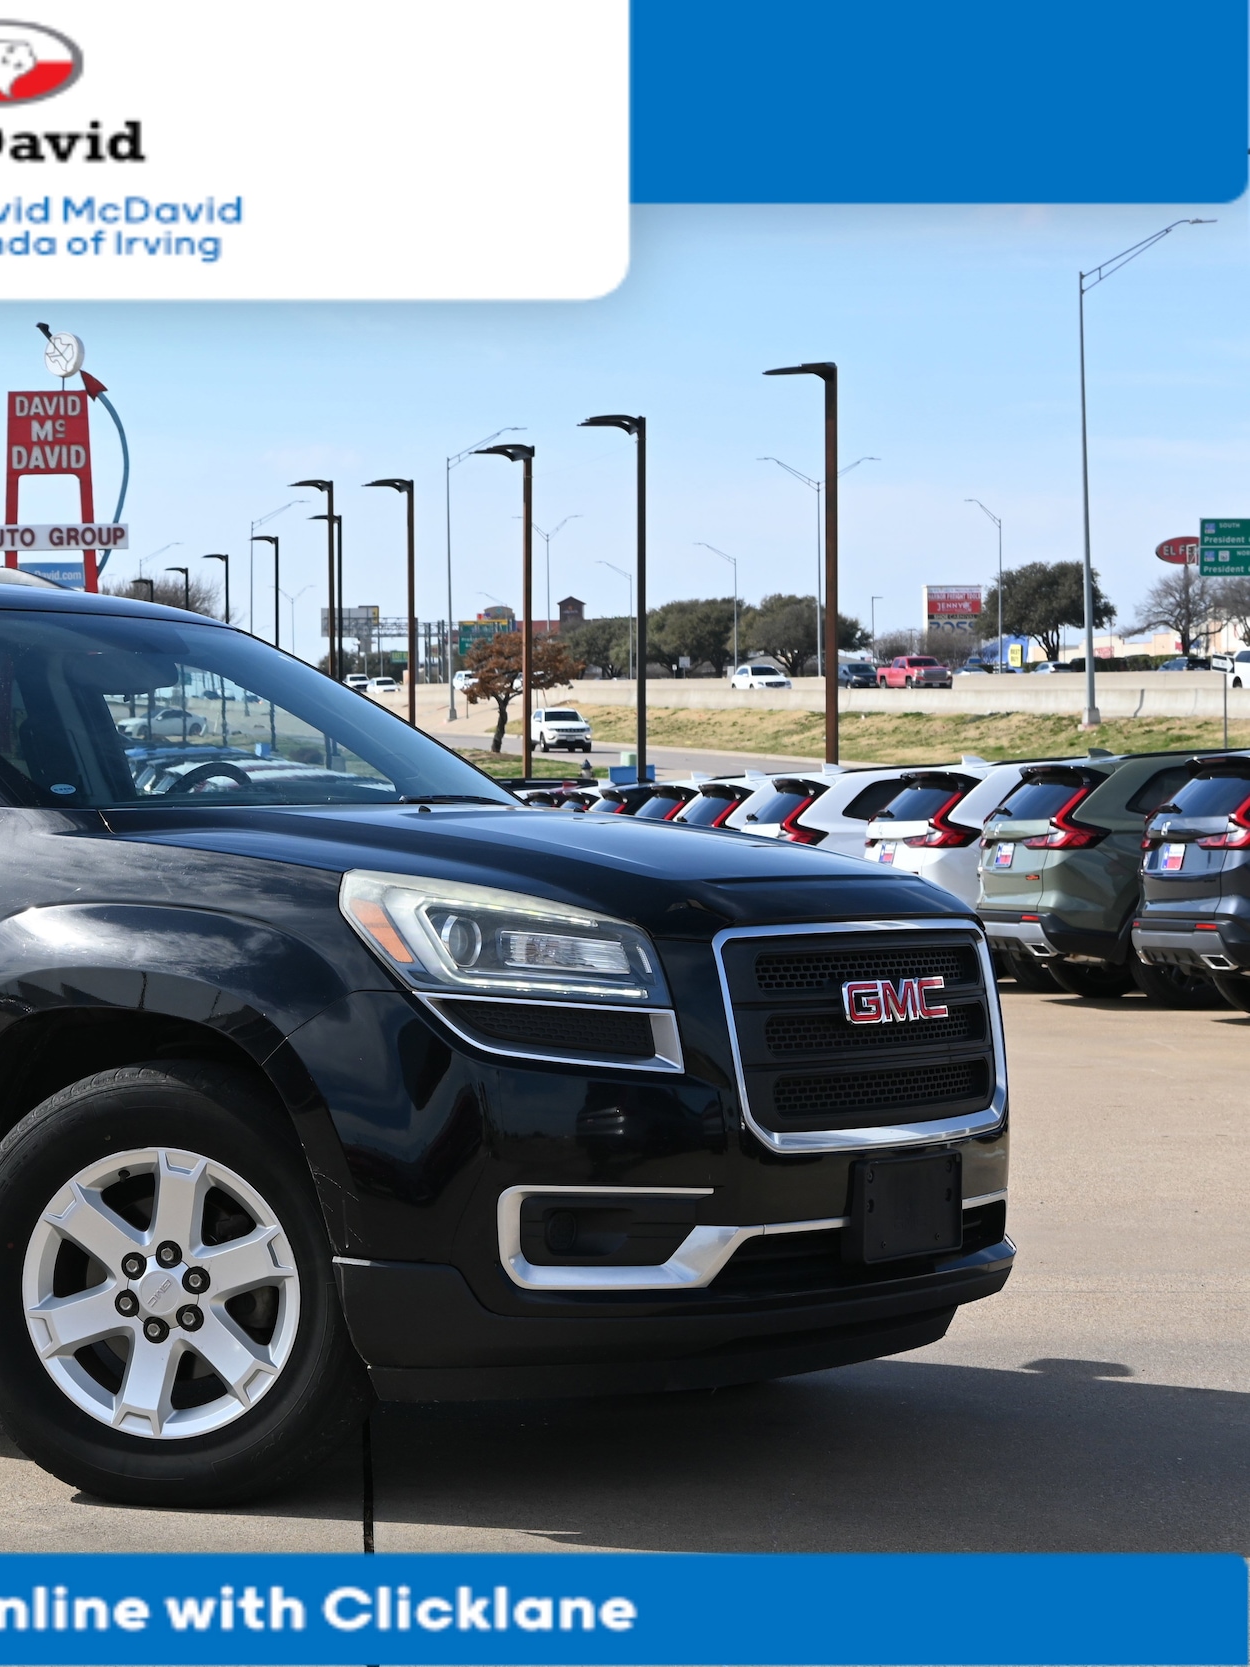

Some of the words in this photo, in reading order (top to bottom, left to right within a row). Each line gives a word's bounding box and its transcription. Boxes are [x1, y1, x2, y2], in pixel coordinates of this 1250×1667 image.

[15, 395, 81, 417] DAVID
[11, 445, 86, 470] DAVID
[49, 526, 125, 546] GROUP
[1163, 545, 1176, 556] EL
[1203, 565, 1245, 573] President
[842, 975, 949, 1024] GMC
